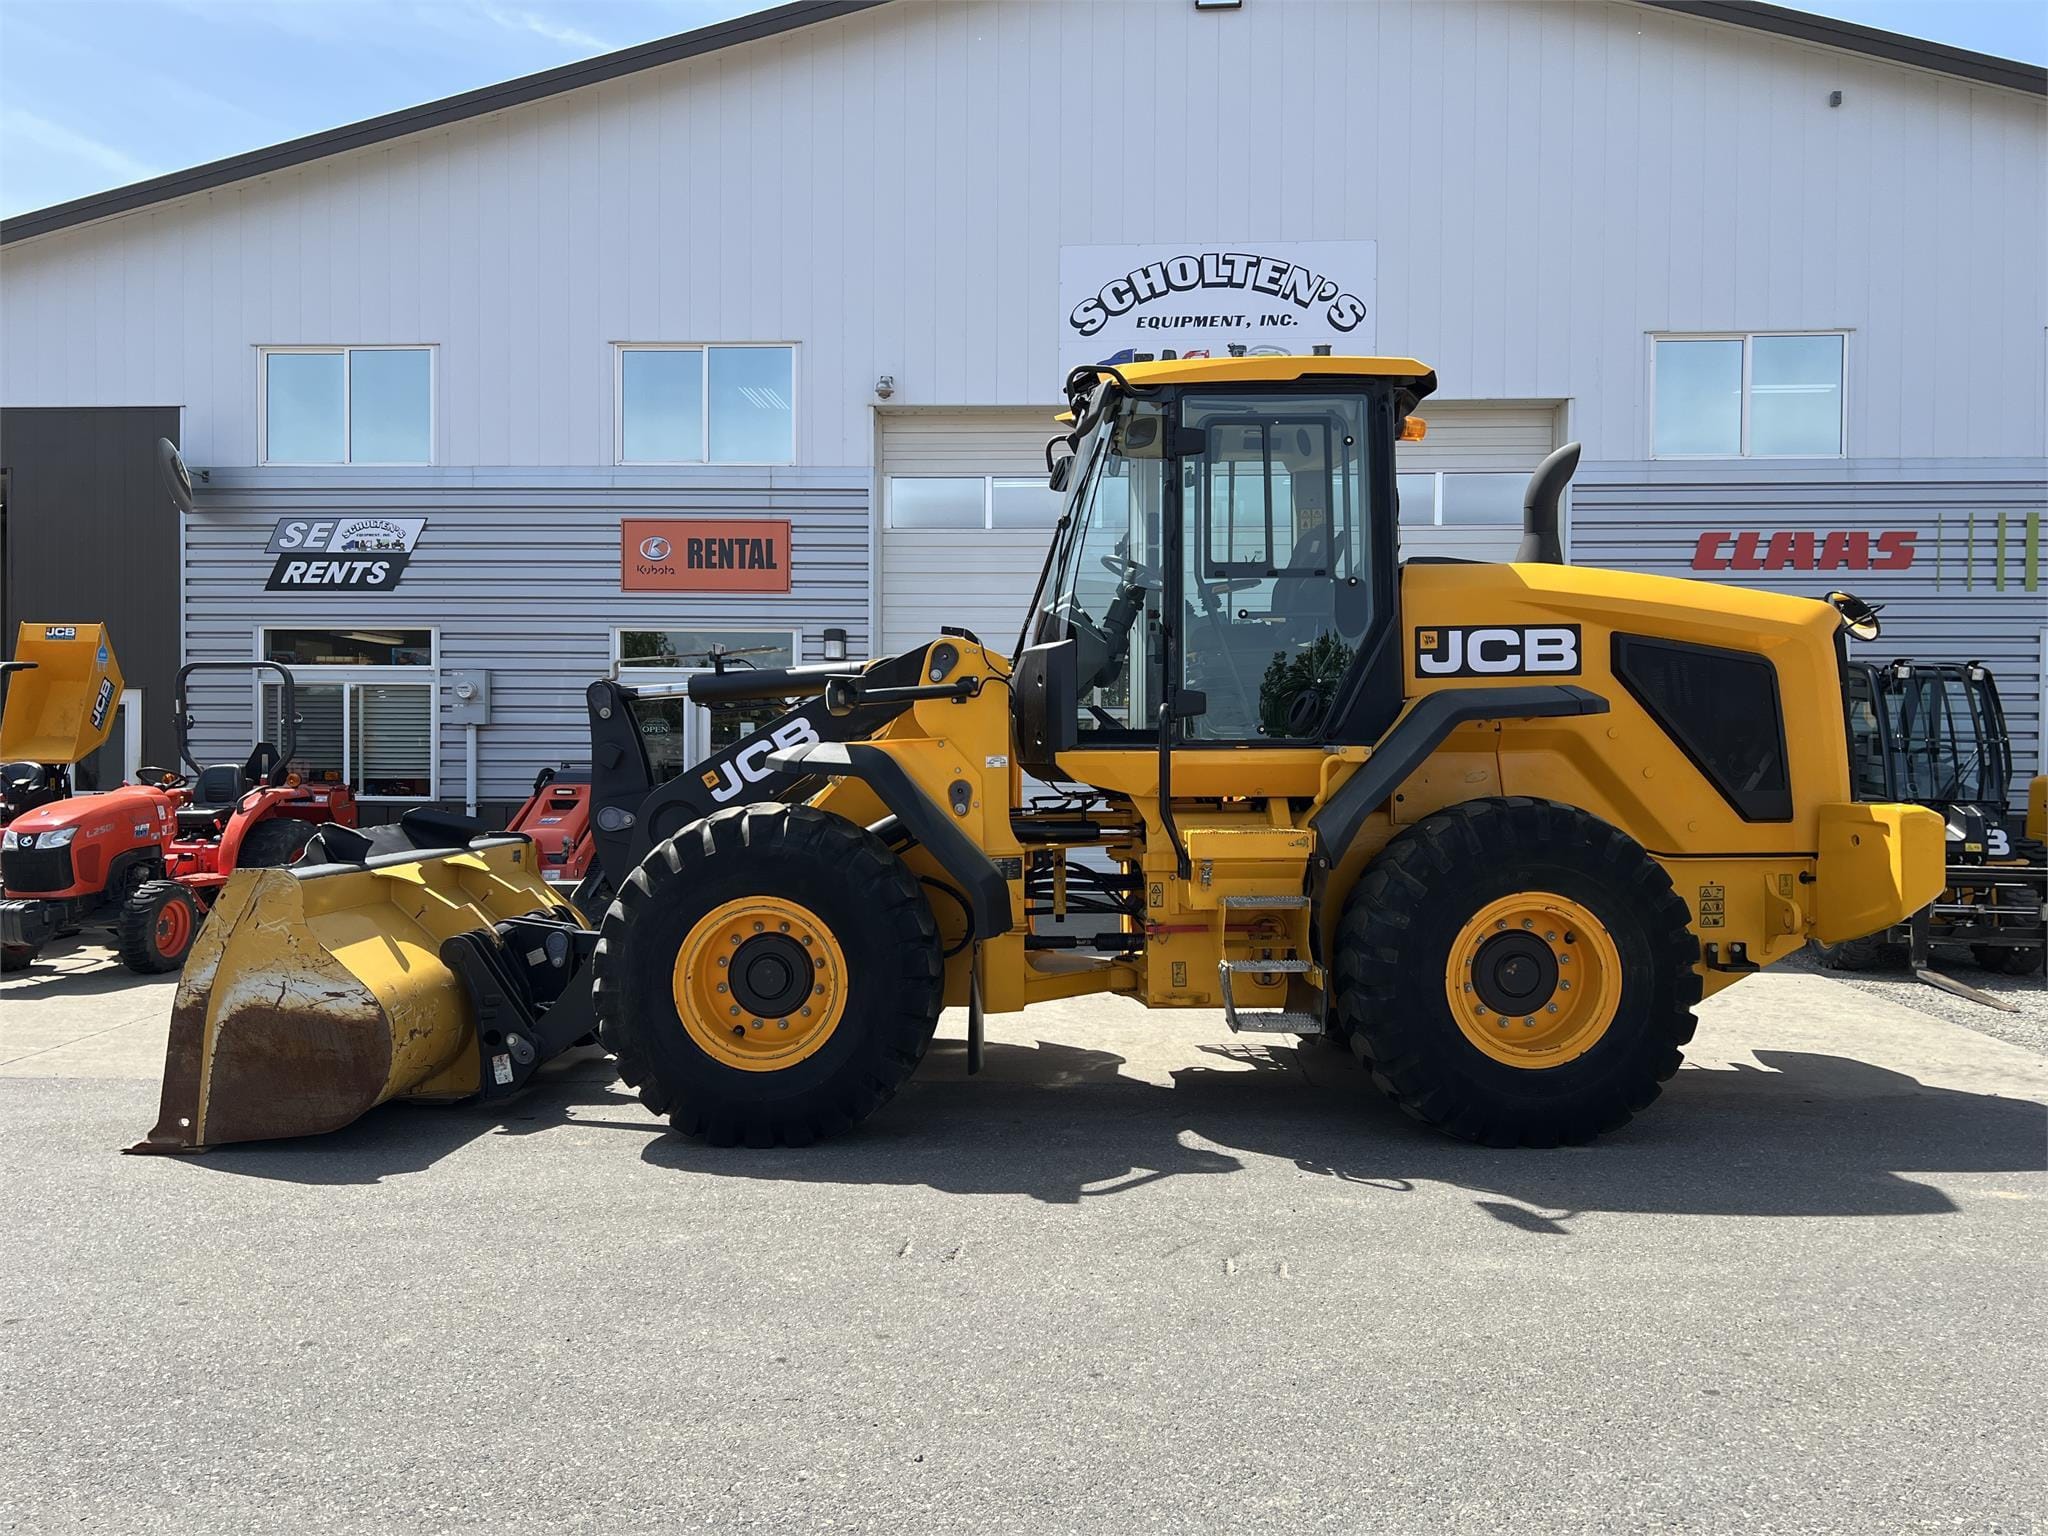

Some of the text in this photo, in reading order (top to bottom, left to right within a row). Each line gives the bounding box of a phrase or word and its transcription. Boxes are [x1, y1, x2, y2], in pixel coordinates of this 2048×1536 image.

[1070, 253, 1367, 336] SCHOLTEN'S
[1136, 314, 1298, 329] EQUIPMENT, INC.
[278, 522, 334, 548] SE
[687, 537, 777, 569] RENTAL
[1691, 532, 1918, 570] CLAAS
[280, 561, 390, 584] RENTS
[636, 565, 675, 575] Kubota
[45, 627, 76, 637] JCB
[1420, 629, 1578, 674] JCB
[93, 679, 112, 726] JCB
[642, 725, 668, 733] OPEN
[711, 717, 820, 803] JCB
